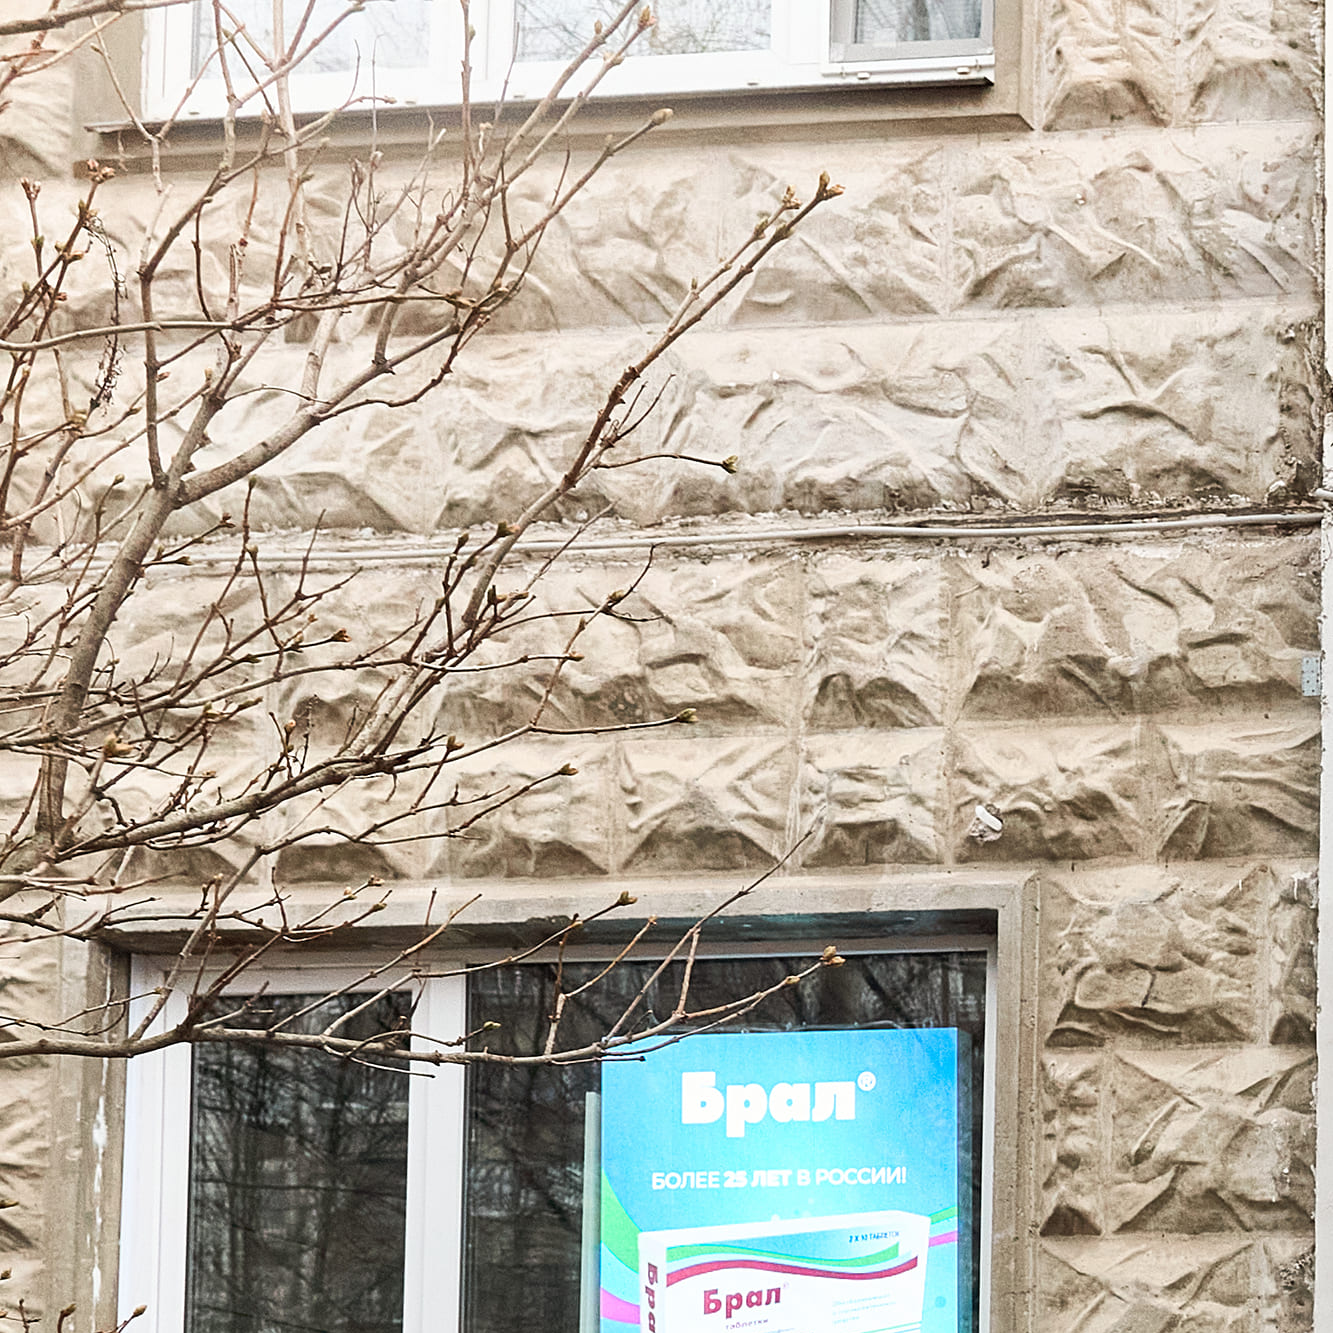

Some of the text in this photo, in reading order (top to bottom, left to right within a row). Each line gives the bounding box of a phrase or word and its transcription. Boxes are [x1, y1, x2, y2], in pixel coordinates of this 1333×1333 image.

[651, 1166, 907, 1190] БОЛЕЕ 25 ЛЕТ В РОССИИ!
